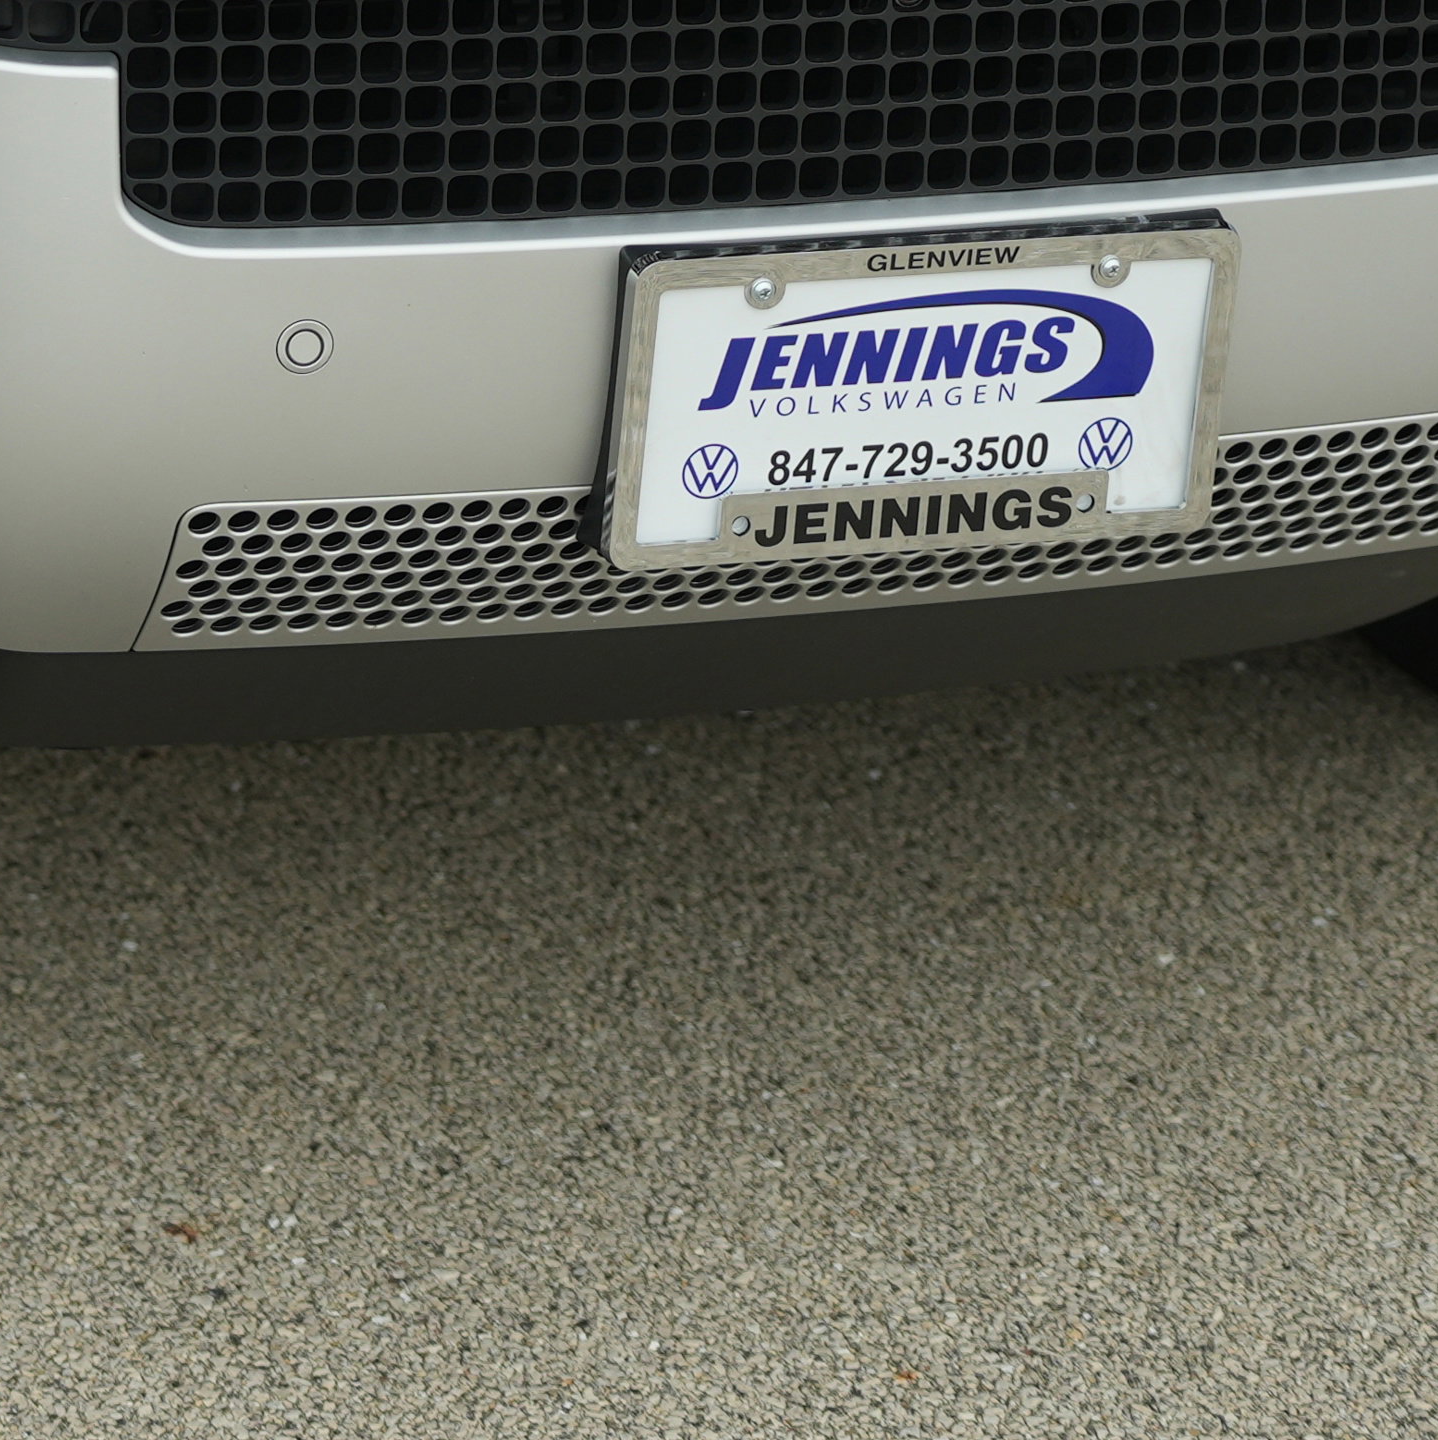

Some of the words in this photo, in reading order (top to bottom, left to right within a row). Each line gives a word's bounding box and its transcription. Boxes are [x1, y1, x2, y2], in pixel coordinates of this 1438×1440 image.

[866, 245, 1021, 273] GLENVIEW
[697, 315, 1076, 411] JENNINGS
[749, 382, 1017, 417] VOLKSWAGEN
[767, 432, 1050, 485] 847-729-3500
[754, 486, 1073, 548] JENNINGS
